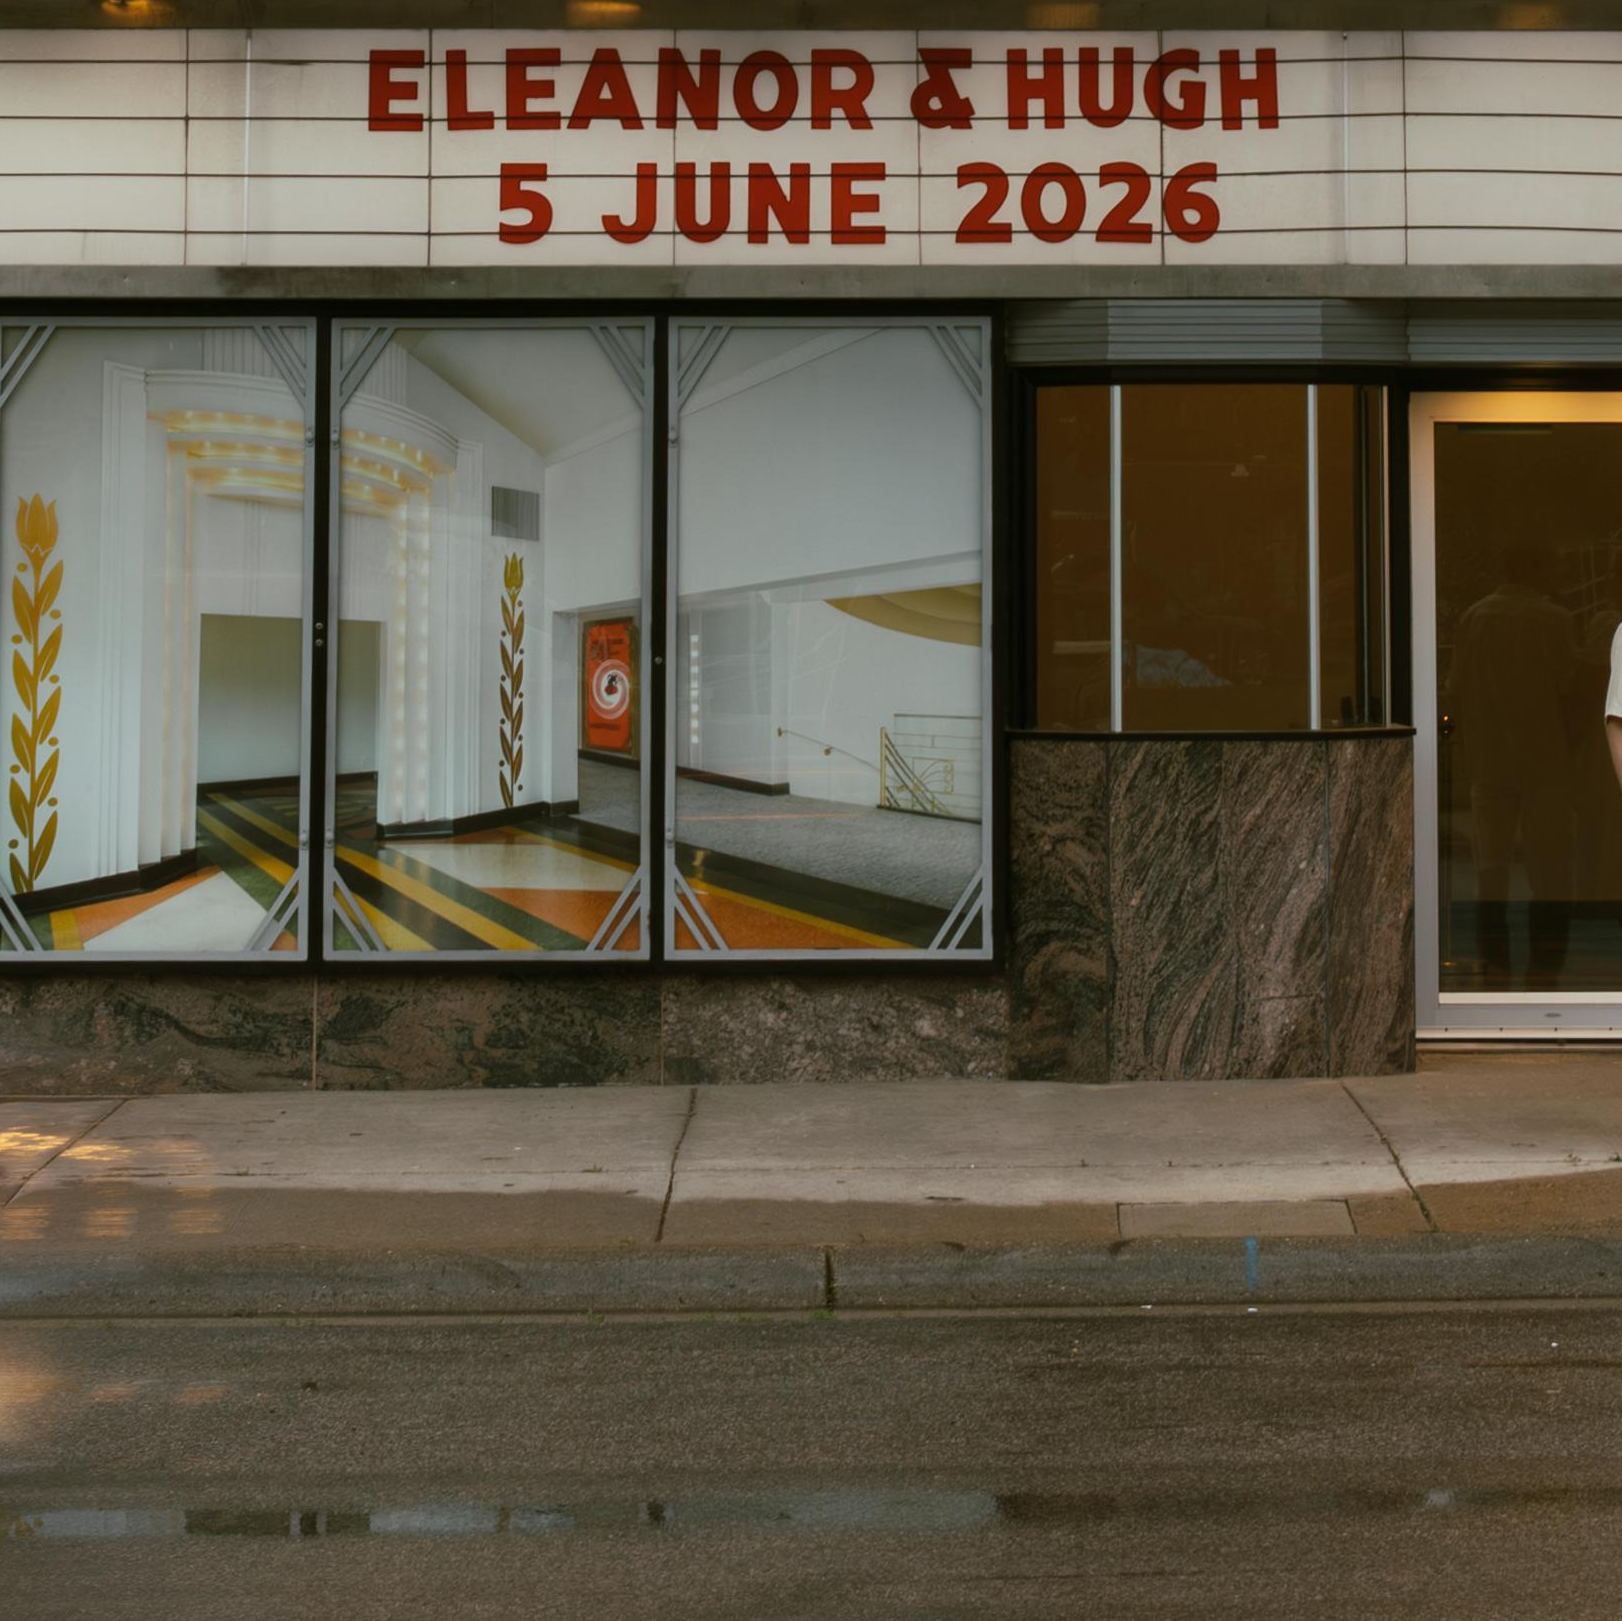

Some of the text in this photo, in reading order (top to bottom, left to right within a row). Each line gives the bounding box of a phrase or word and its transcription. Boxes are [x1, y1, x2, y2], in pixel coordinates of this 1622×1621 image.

[369, 49, 1278, 131] ELEANOR & HUGH
[500, 162, 1219, 244] 5 JUNE 2026
